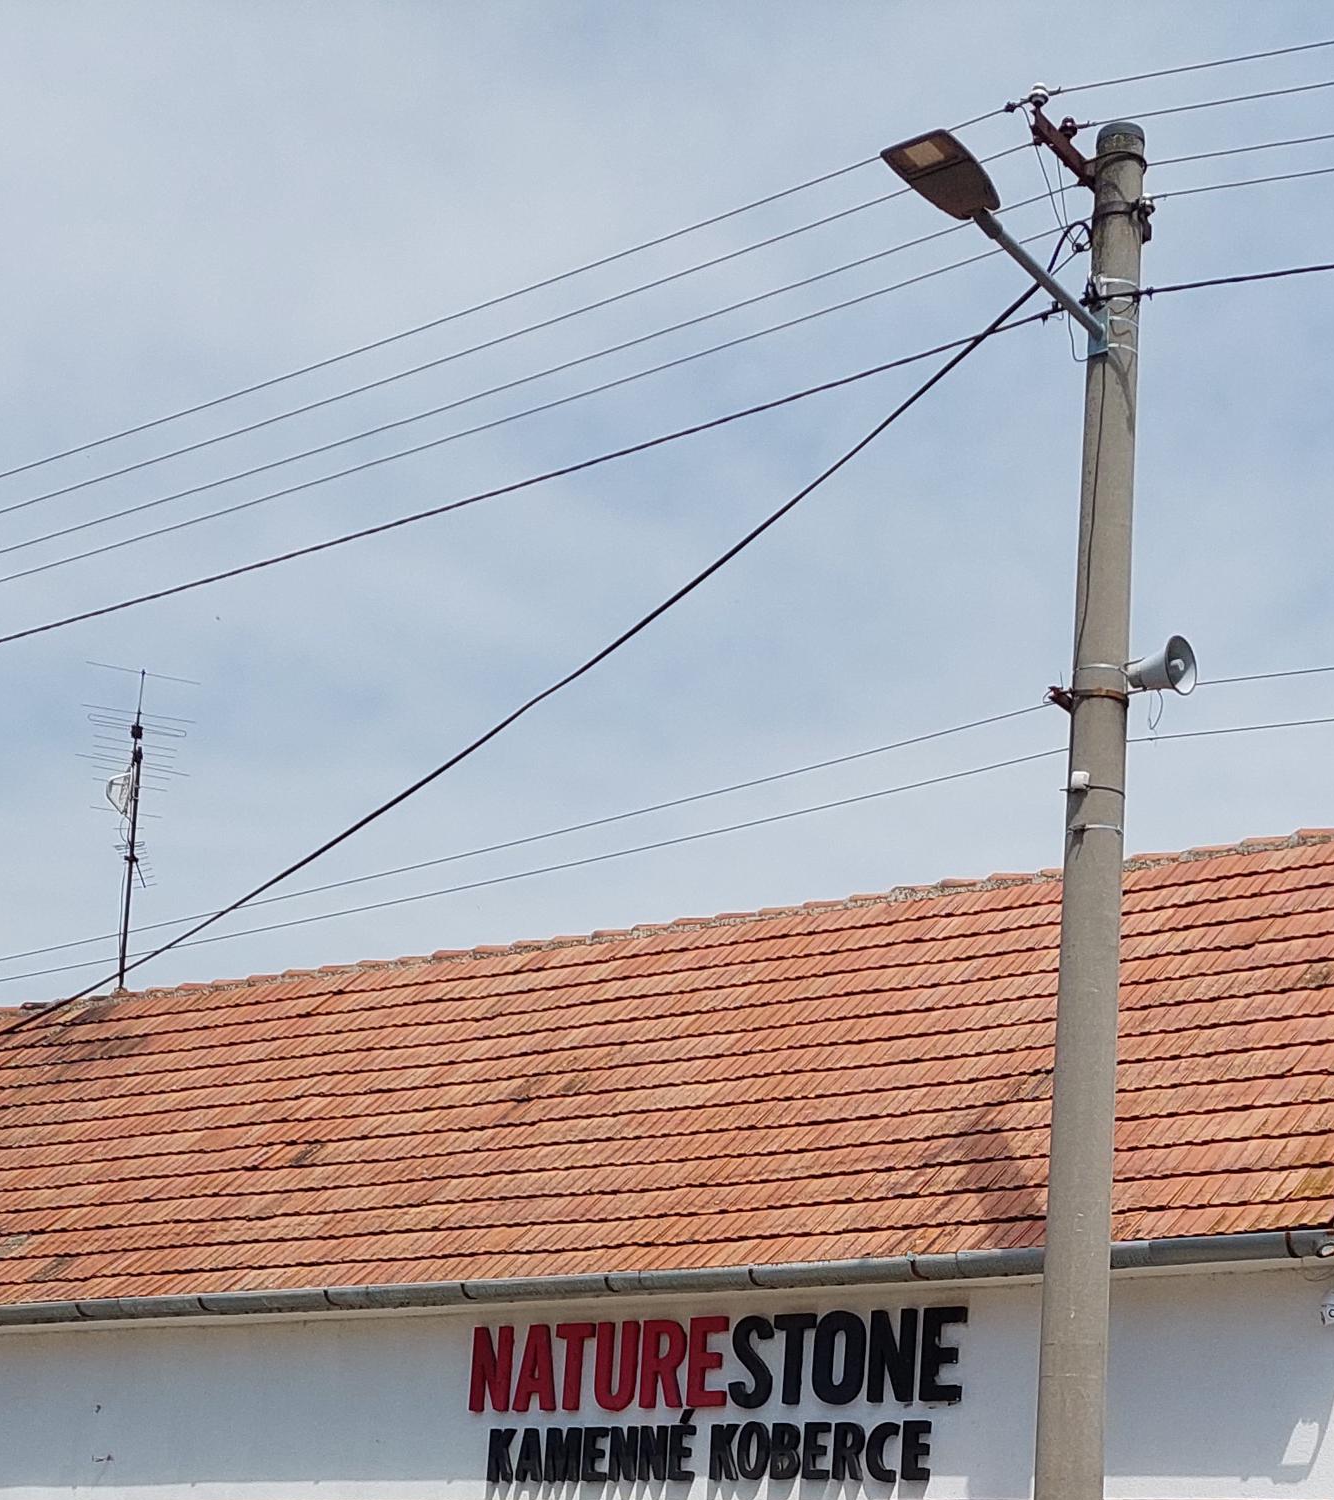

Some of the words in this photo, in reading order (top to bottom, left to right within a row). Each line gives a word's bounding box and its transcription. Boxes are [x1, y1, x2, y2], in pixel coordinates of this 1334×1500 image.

[469, 1306, 968, 1412] NATURESTONE
[486, 1409, 697, 1484] KAMENNÉ
[709, 1420, 933, 1483] KOBERCE
